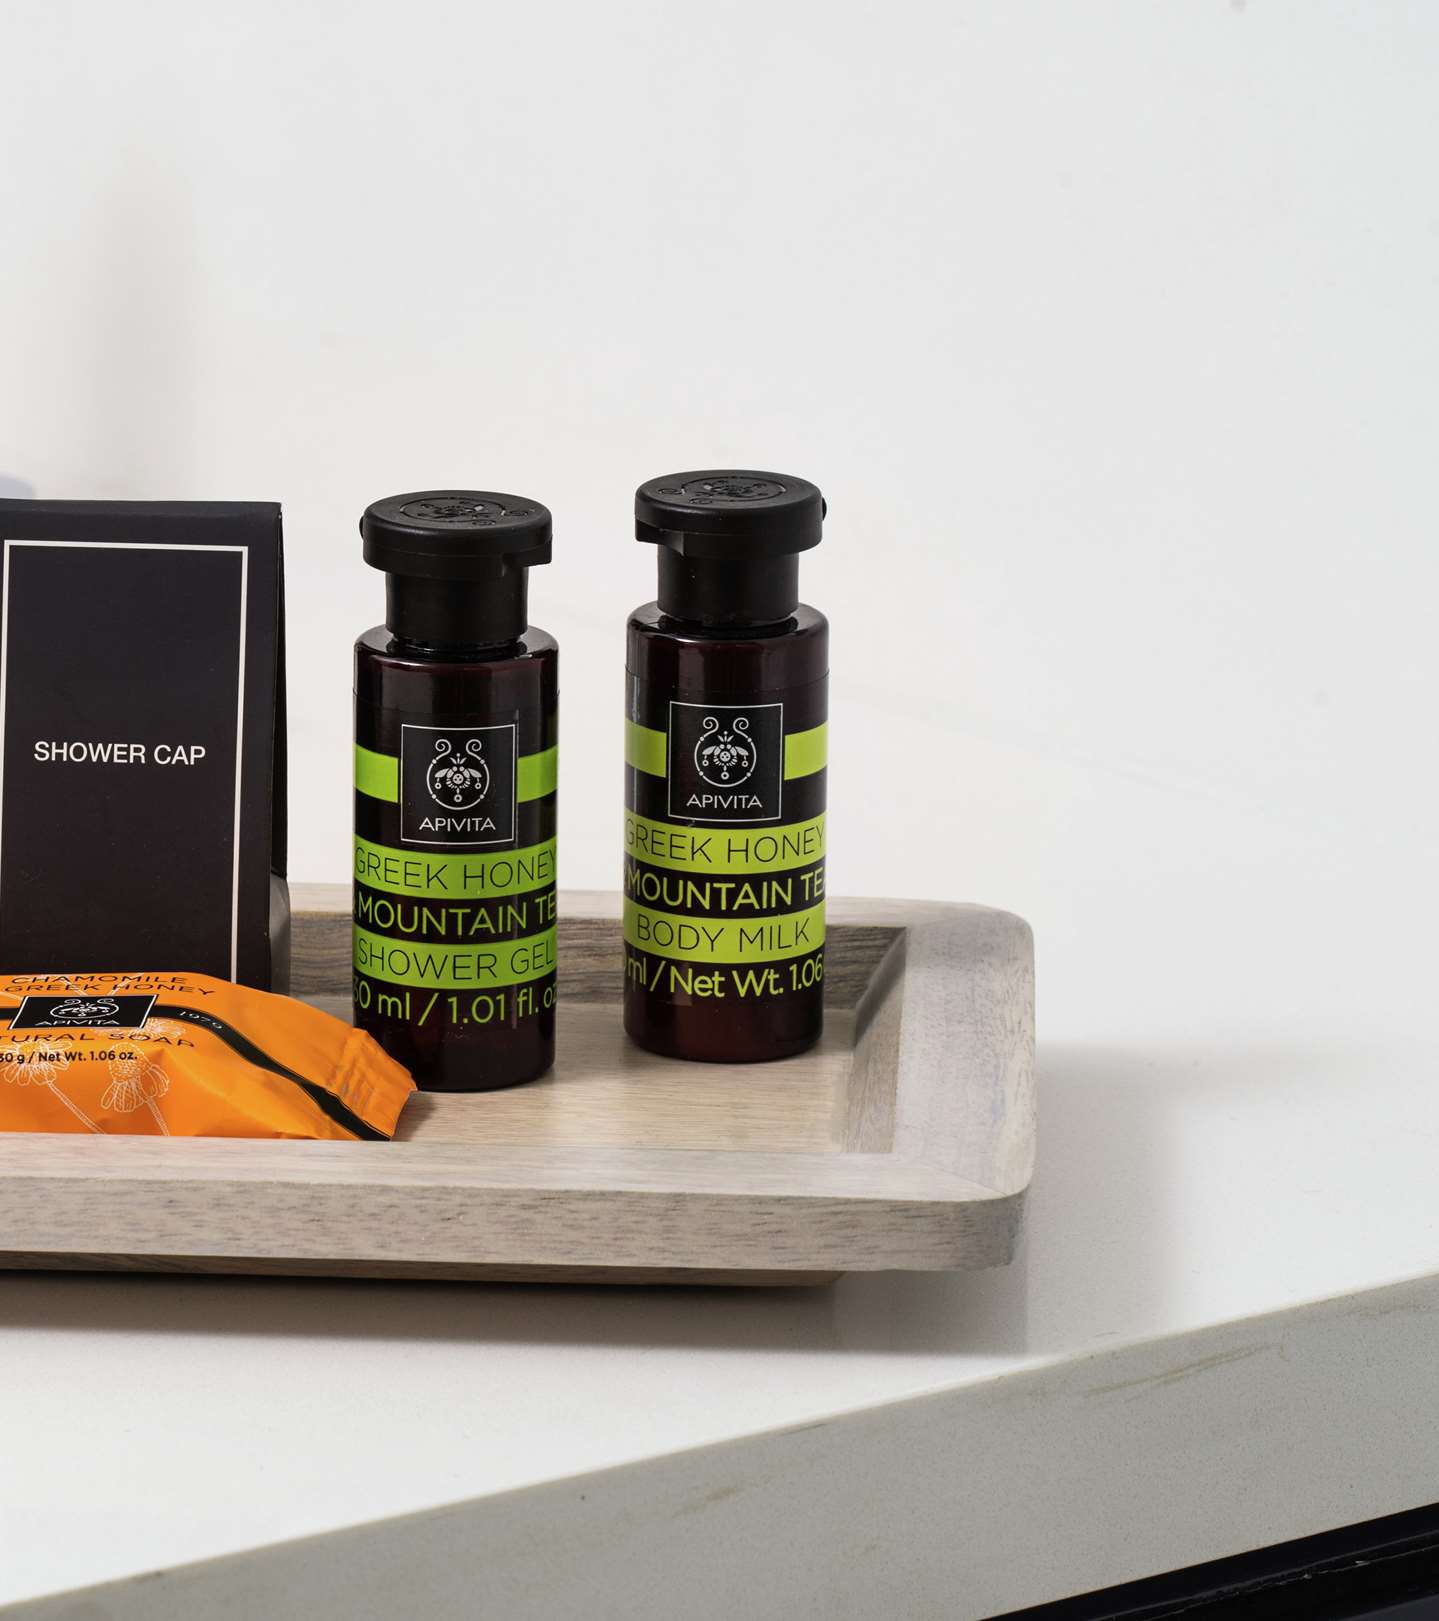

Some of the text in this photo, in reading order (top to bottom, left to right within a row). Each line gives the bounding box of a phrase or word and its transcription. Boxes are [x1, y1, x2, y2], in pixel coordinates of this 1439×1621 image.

[34, 741, 206, 765] SHOWER CAP
[686, 794, 763, 809] APIVITA
[419, 817, 496, 832] APIVITA
[625, 818, 825, 864] GREEK HONEY
[355, 846, 556, 890] GREEK HONEY
[627, 863, 825, 911] MOUNTAIN TE
[358, 889, 527, 936] MOUNTAIN
[637, 914, 810, 953] BODY MILK
[358, 937, 554, 981] SHOWER GEL
[4, 984, 101, 992] GREEK
[112, 984, 216, 996] HONEY
[11, 975, 188, 985] CHAMOMILE
[732, 968, 784, 998] Wt.
[789, 953, 823, 991] 1.06
[378, 991, 410, 1020] ml
[447, 993, 505, 1026] 1.01
[517, 986, 540, 1018] fl.
[34, 1019, 120, 1027] APIVITA
[108, 1033, 195, 1048] SOAP
[16, 1054, 25, 1064] g
[27, 1051, 35, 1064] /
[39, 1051, 61, 1062] Net
[64, 1051, 87, 1062] Wt.
[90, 1050, 116, 1062] 1.06
[118, 1051, 138, 1061] oz.
